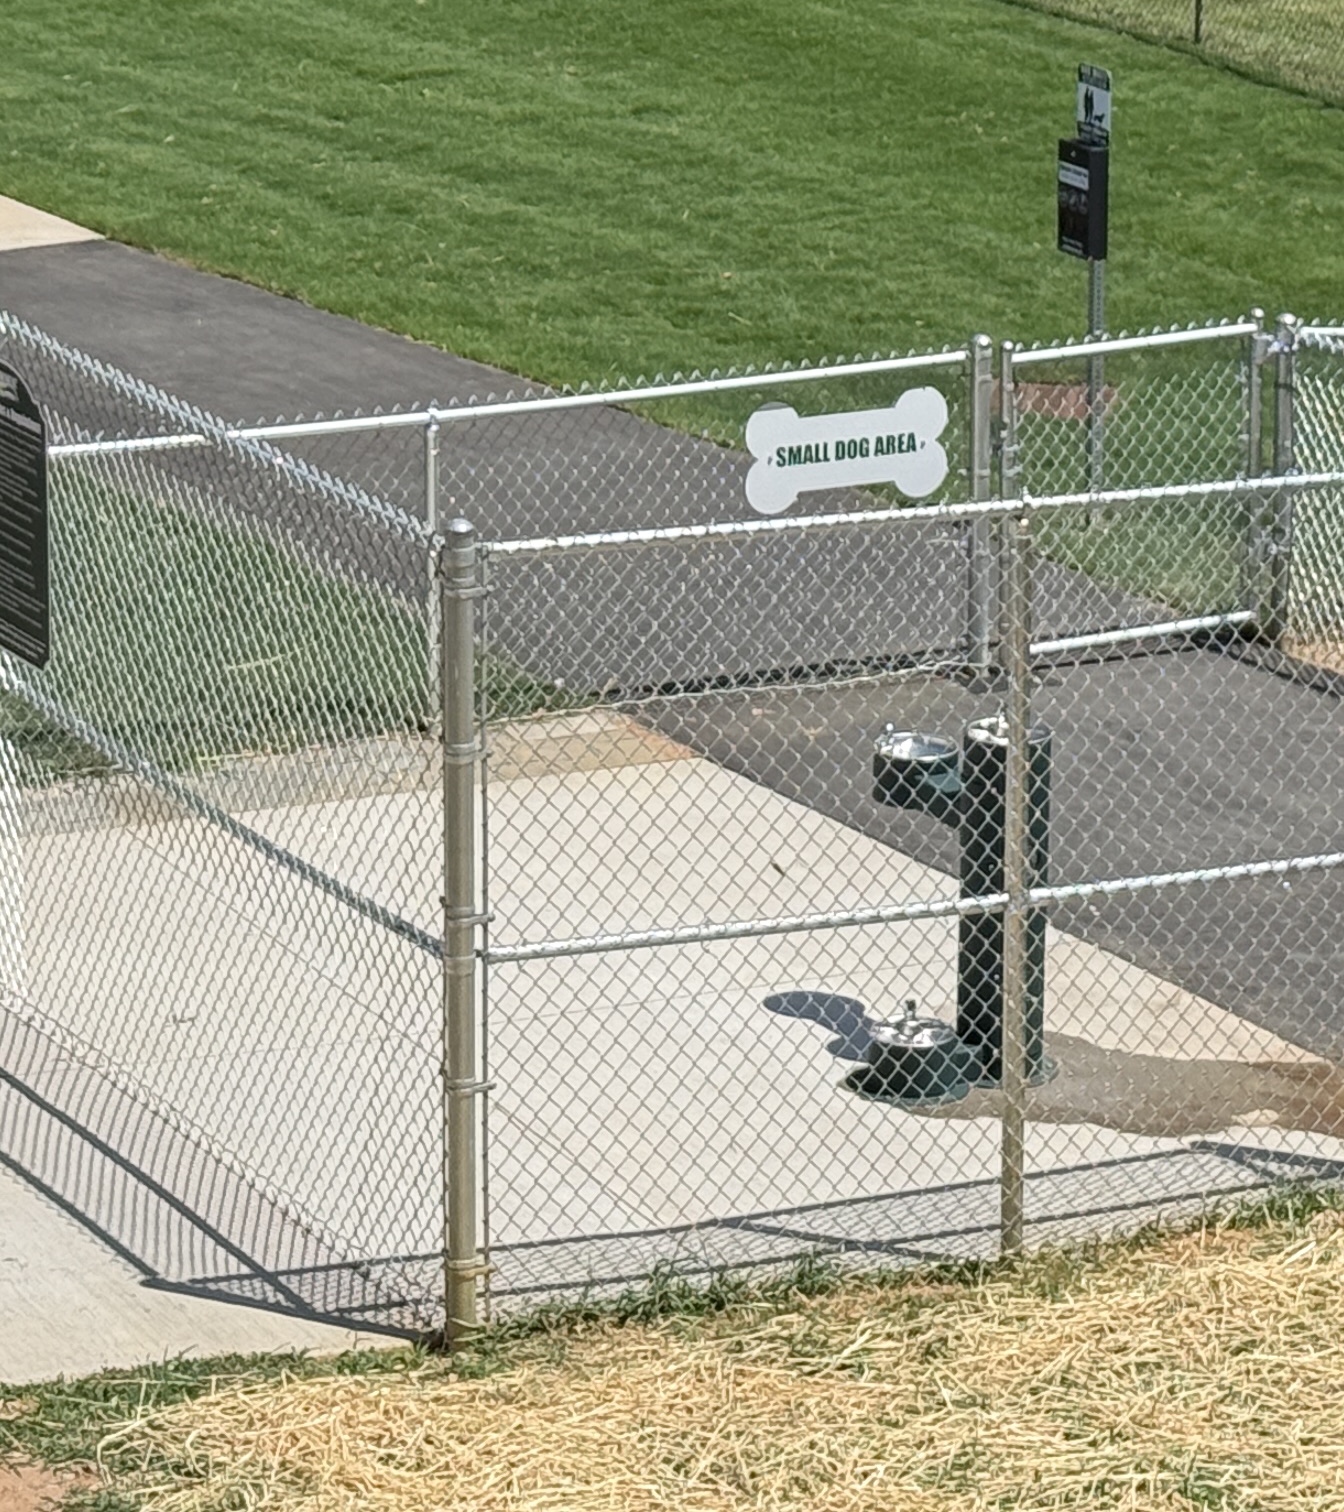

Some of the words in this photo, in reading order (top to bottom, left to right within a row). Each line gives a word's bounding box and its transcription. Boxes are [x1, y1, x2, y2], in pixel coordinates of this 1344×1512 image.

[776, 442, 831, 468] SMALL
[835, 437, 870, 462] DOG
[874, 432, 917, 457] AREA
